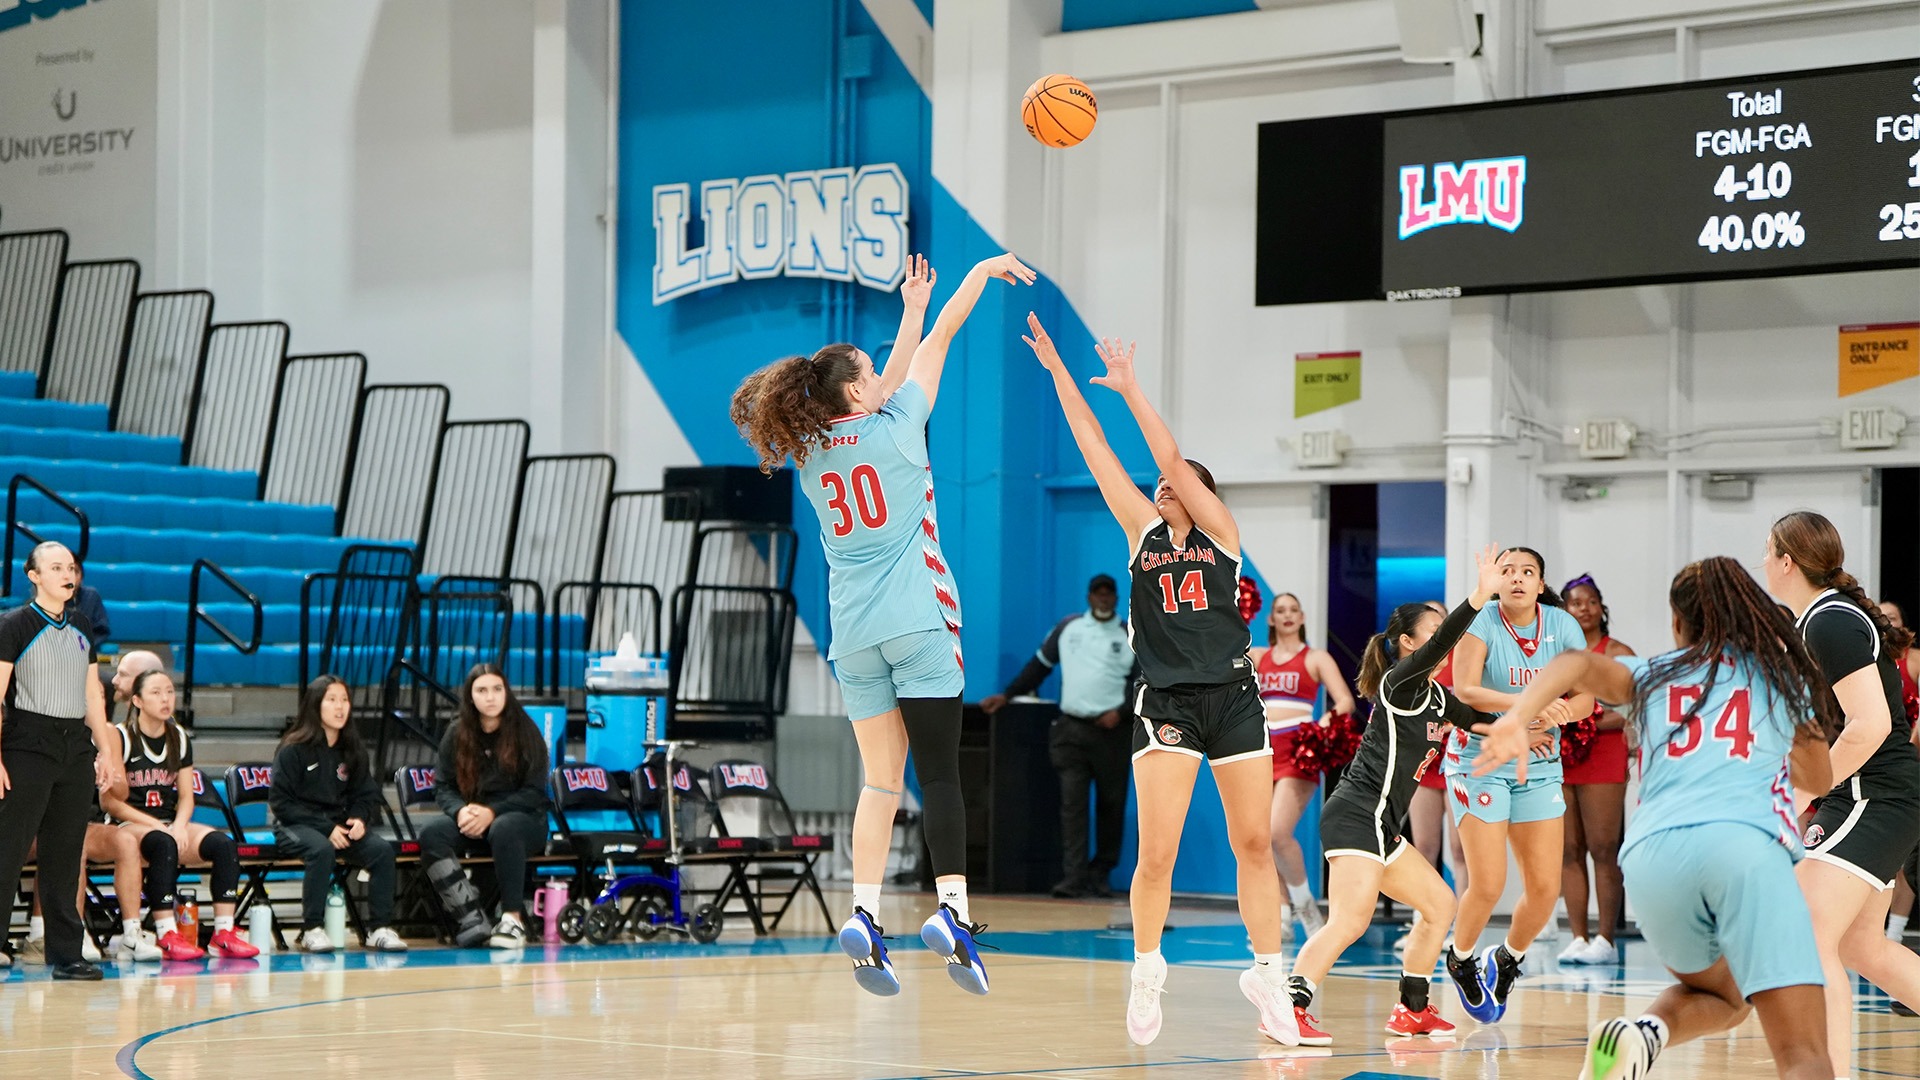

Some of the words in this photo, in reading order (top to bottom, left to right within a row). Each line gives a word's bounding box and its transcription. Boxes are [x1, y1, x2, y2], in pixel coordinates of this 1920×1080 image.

[1727, 88, 1782, 117] Total
[0, 128, 134, 164] UNIVERSITY
[1696, 122, 1812, 157] FGM-FGA
[1714, 161, 1792, 202] 4-10
[1398, 155, 1526, 240] LMU
[653, 162, 909, 307] LIONS
[1698, 211, 1805, 253] 40.0%
[1386, 286, 1462, 301] DAKTRONICS
[1849, 340, 1908, 353] ENTRANCE
[1849, 354, 1879, 365] ONLY
[1303, 373, 1323, 384] EXIT
[1326, 372, 1350, 384] ONLY
[1586, 421, 1617, 450] EXIT
[1849, 409, 1885, 441] EXIT
[1303, 431, 1331, 459] EXIT
[820, 463, 888, 537] 30
[1140, 546, 1216, 572] CHAPMAN
[1159, 570, 1208, 614] 14
[1665, 684, 1757, 763] 54
[238, 767, 272, 790] LM
[563, 768, 609, 792] LMU
[720, 764, 769, 790] LMU
